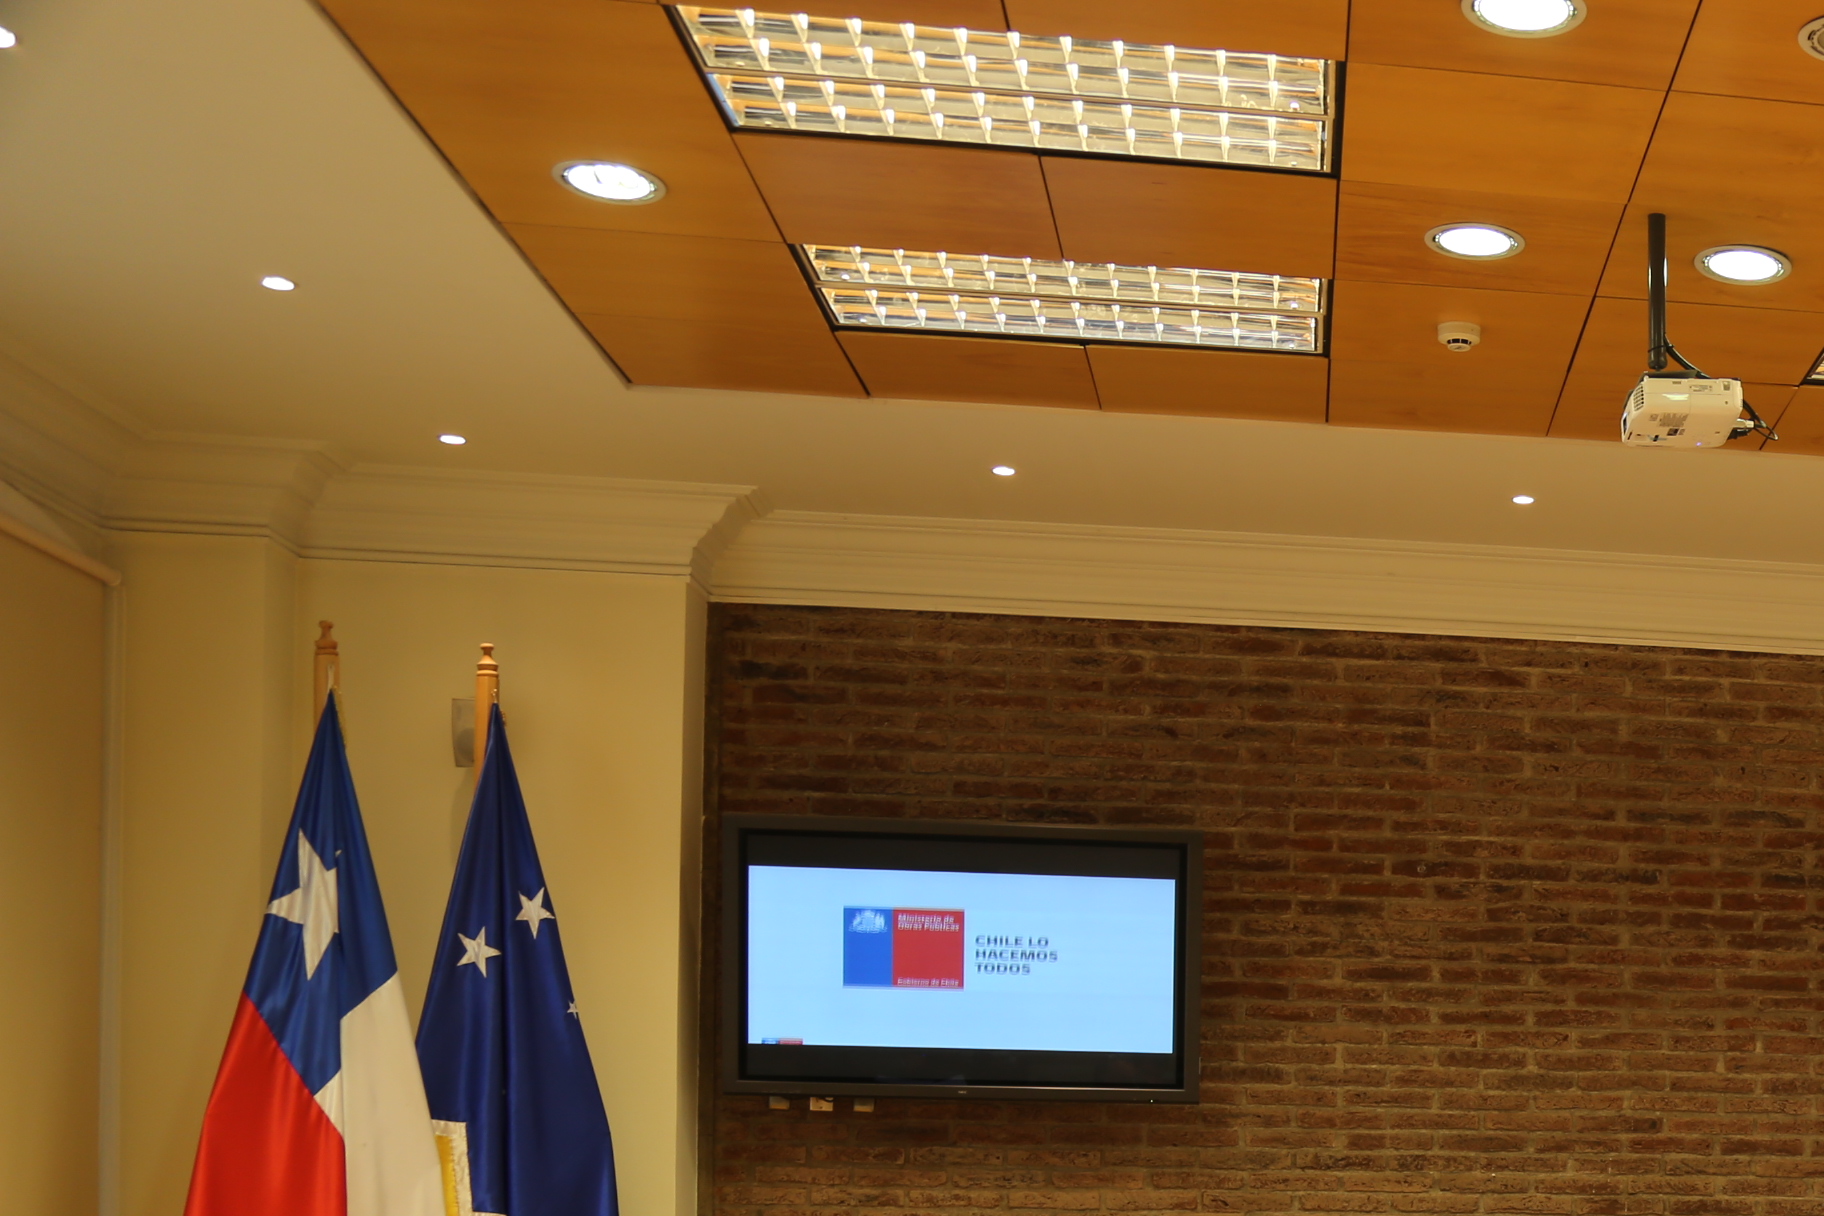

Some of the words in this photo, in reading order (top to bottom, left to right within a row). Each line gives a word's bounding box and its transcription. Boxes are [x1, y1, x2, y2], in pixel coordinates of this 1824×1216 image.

[975, 935, 1023, 948] CHILE
[1028, 936, 1049, 948] LO
[975, 949, 1058, 963] HACEMOS
[975, 963, 1031, 975] TODOS
